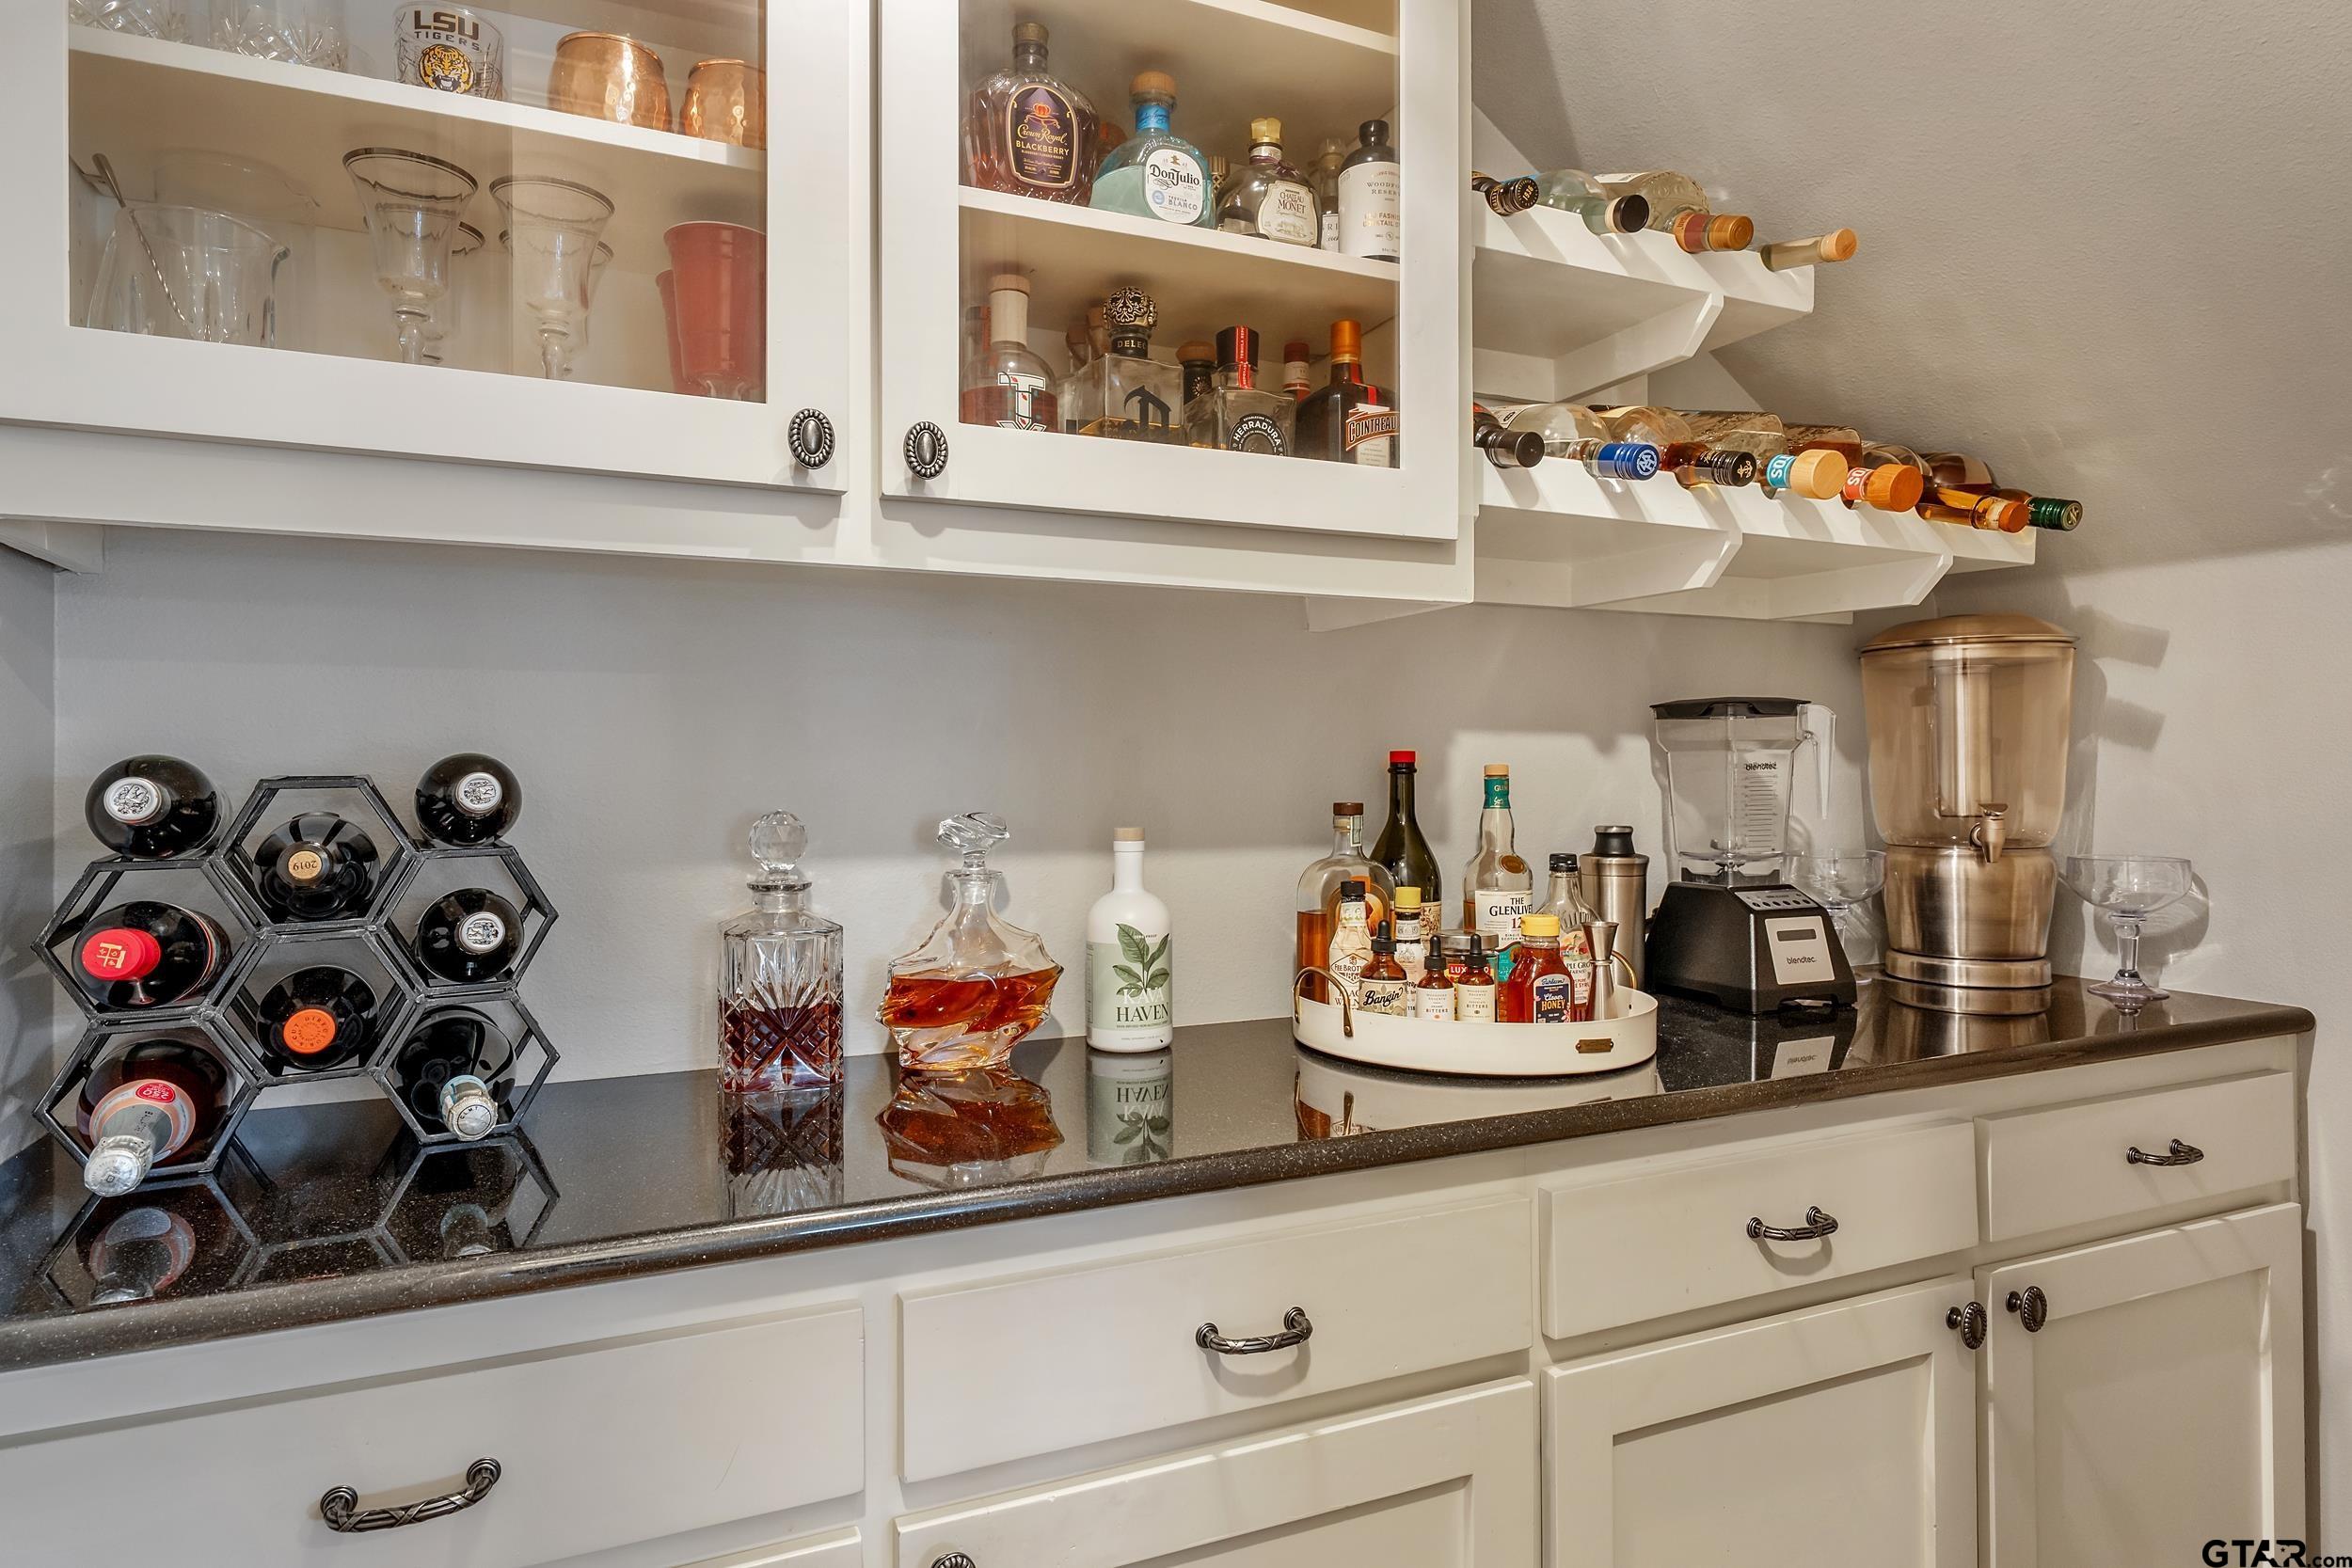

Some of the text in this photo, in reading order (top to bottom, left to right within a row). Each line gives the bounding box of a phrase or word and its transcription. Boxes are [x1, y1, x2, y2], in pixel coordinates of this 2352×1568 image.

[414, 9, 479, 40] LSU
[414, 31, 480, 52] TIGERS
[1017, 123, 1068, 144] Crown Royal
[1015, 140, 1070, 156] BLACKBERRY
[1168, 198, 1199, 211] BLANCO
[1278, 198, 1306, 214] MONET
[1232, 420, 1281, 446] HERRADURA
[1348, 415, 1398, 444] COINTREAU
[293, 860, 317, 871] 2019
[1510, 896, 1524, 905] THE
[1334, 963, 1343, 972] FEE
[1786, 956, 1816, 965] blendtec
[1116, 1002, 1168, 1023] HAVEN
[1541, 999, 1565, 1012] HONEY
